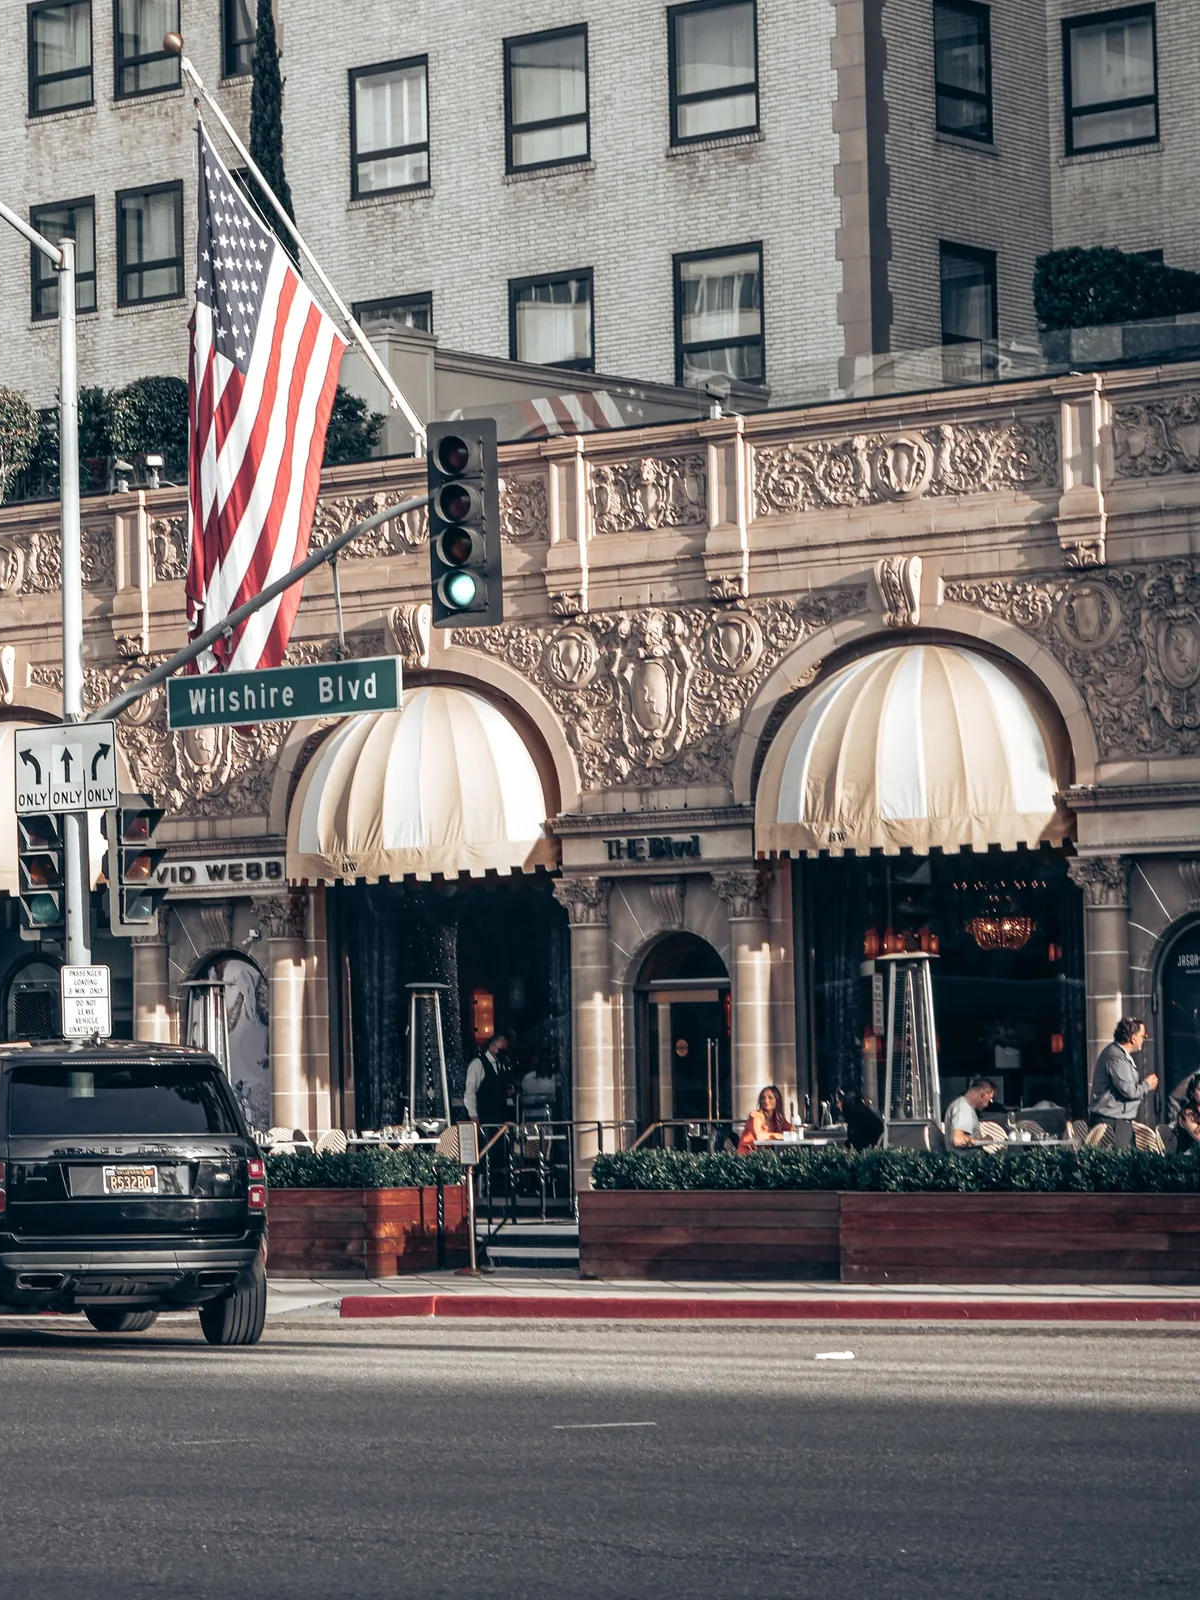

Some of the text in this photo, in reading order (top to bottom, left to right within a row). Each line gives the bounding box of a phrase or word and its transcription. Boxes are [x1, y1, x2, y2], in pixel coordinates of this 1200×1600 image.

[188, 671, 377, 715] Wilshire Blvd
[18, 792, 47, 807] ONLY
[53, 790, 82, 804] ONLY
[87, 788, 114, 802] ONLY
[602, 838, 646, 860] THE
[156, 861, 282, 884] VID WEBB
